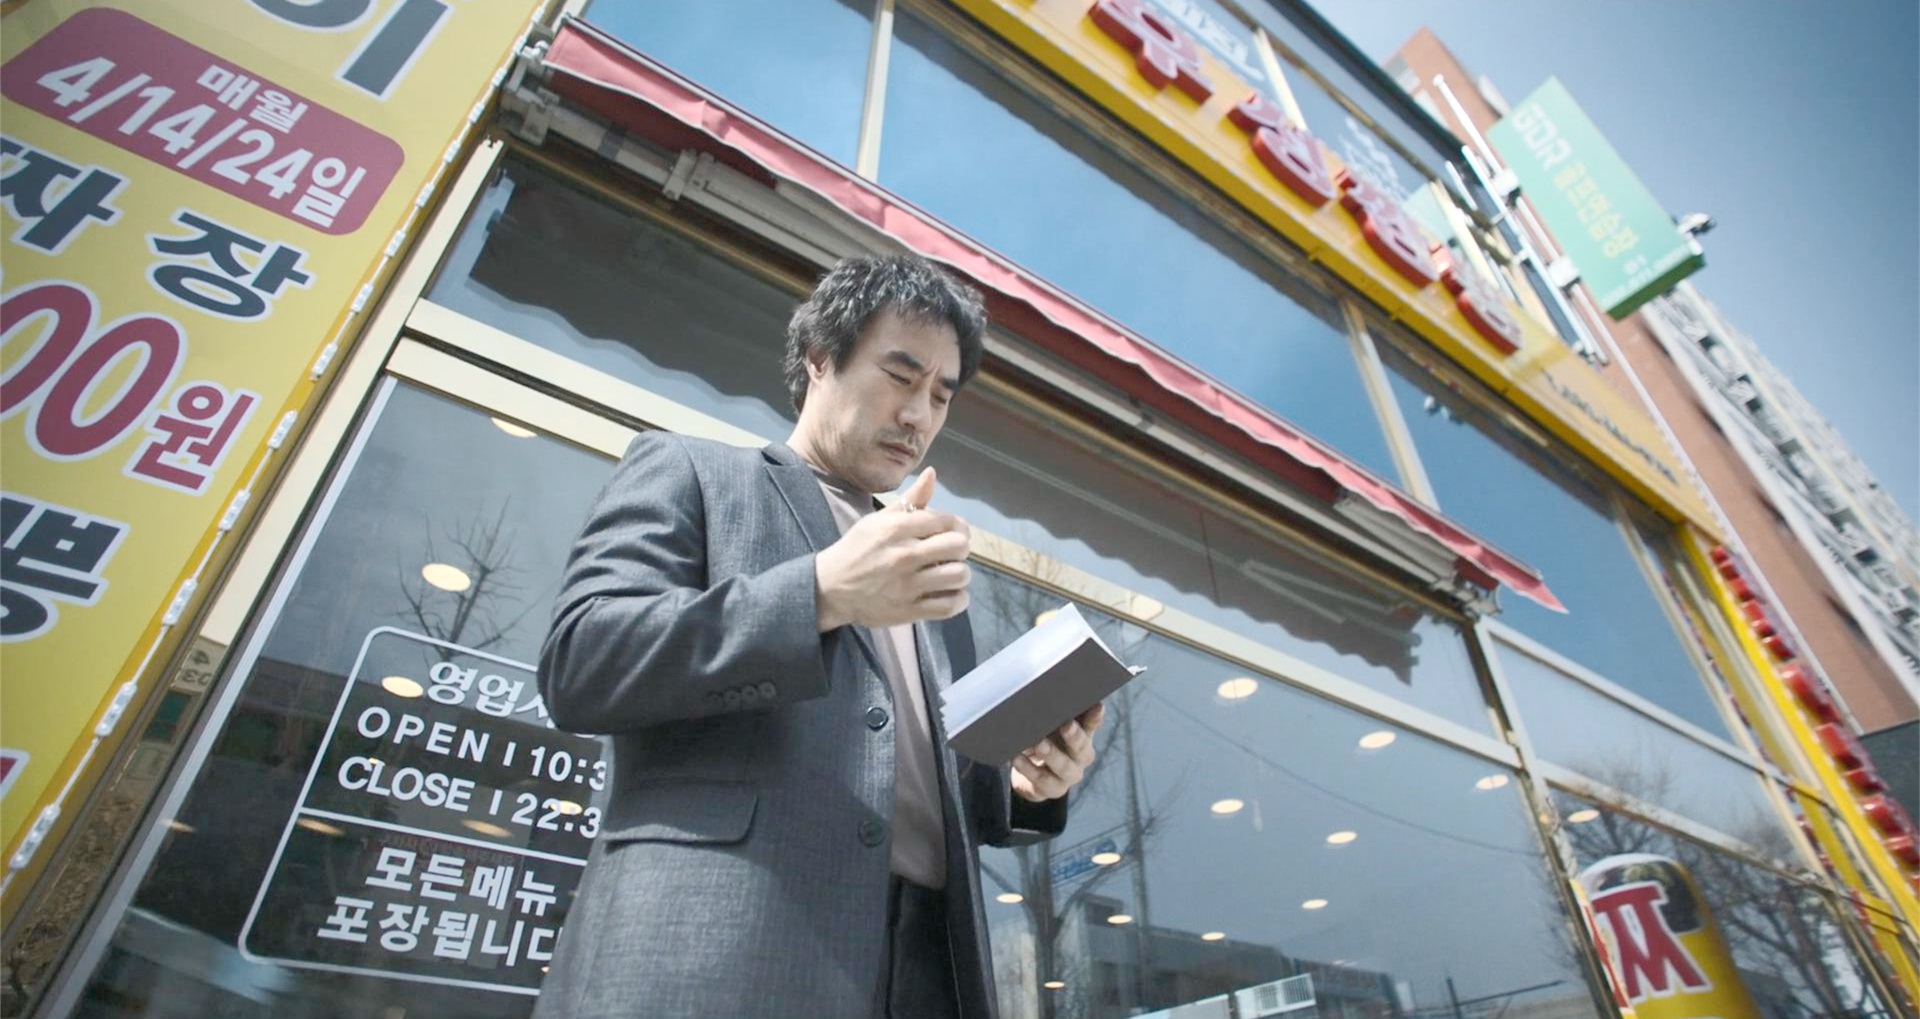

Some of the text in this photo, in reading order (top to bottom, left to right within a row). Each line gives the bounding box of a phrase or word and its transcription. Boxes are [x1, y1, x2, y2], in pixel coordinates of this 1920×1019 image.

[196, 64, 309, 134] 매월
[36, 56, 367, 229] 4/14/24일
[1512, 101, 1572, 170] GDR
[427, 661, 575, 738] 영업
[357, 706, 490, 763] OPEN
[338, 756, 475, 812] CLOSE
